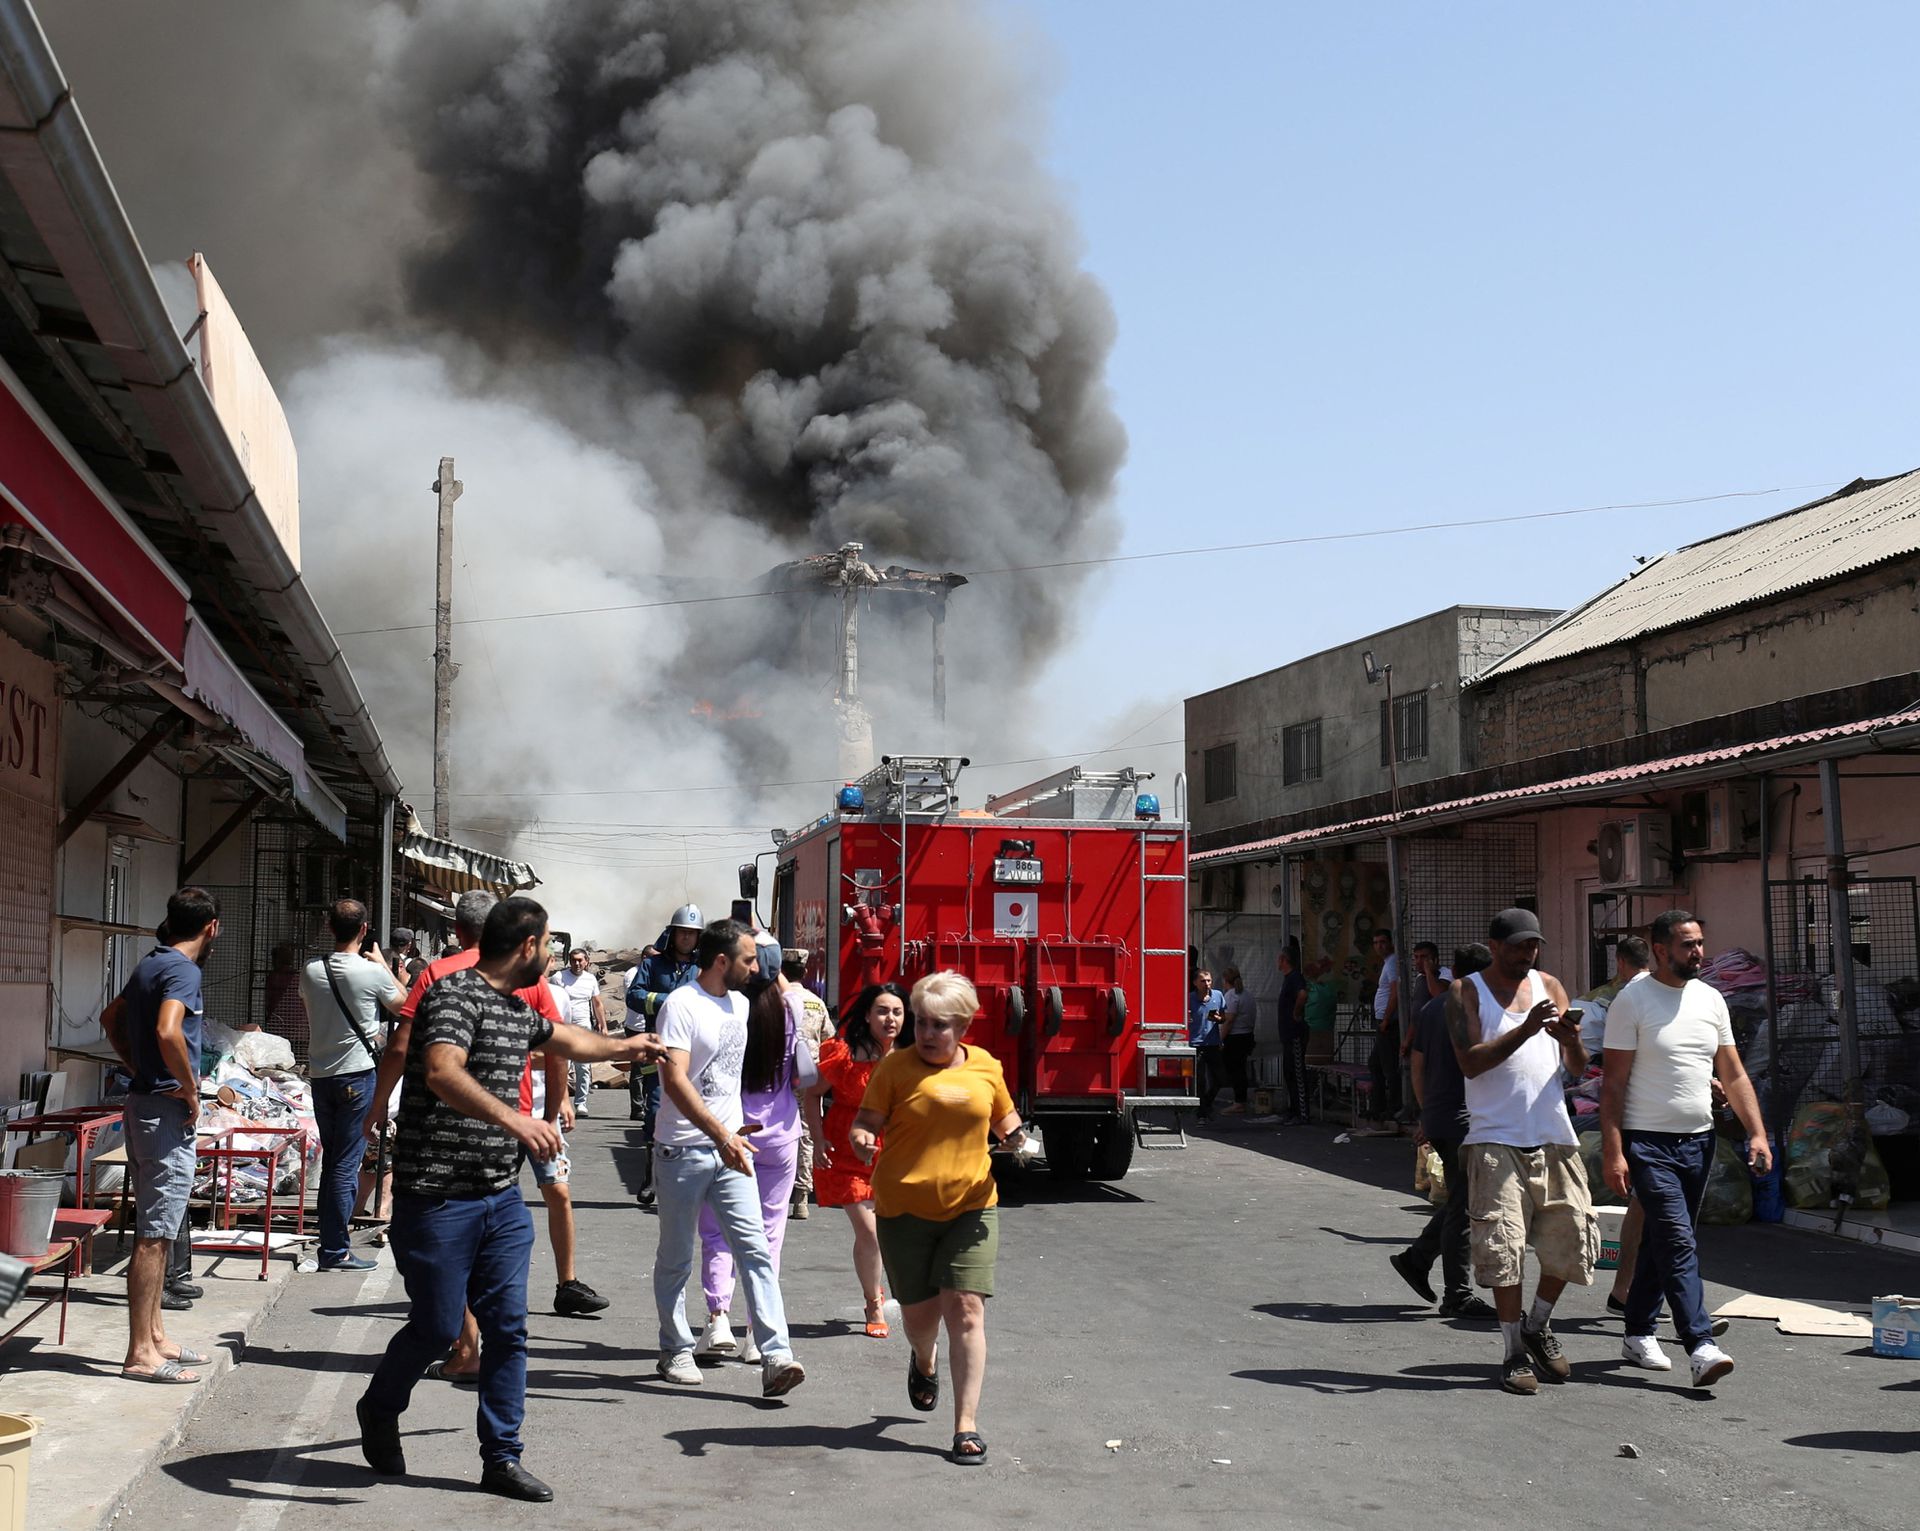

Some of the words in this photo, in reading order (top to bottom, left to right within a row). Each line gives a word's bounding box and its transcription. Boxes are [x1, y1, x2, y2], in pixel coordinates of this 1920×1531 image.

[1015, 861, 1033, 870] 886
[1009, 870, 1023, 880] VV
[1027, 871, 1038, 880] 01
[689, 912, 696, 921] 9
